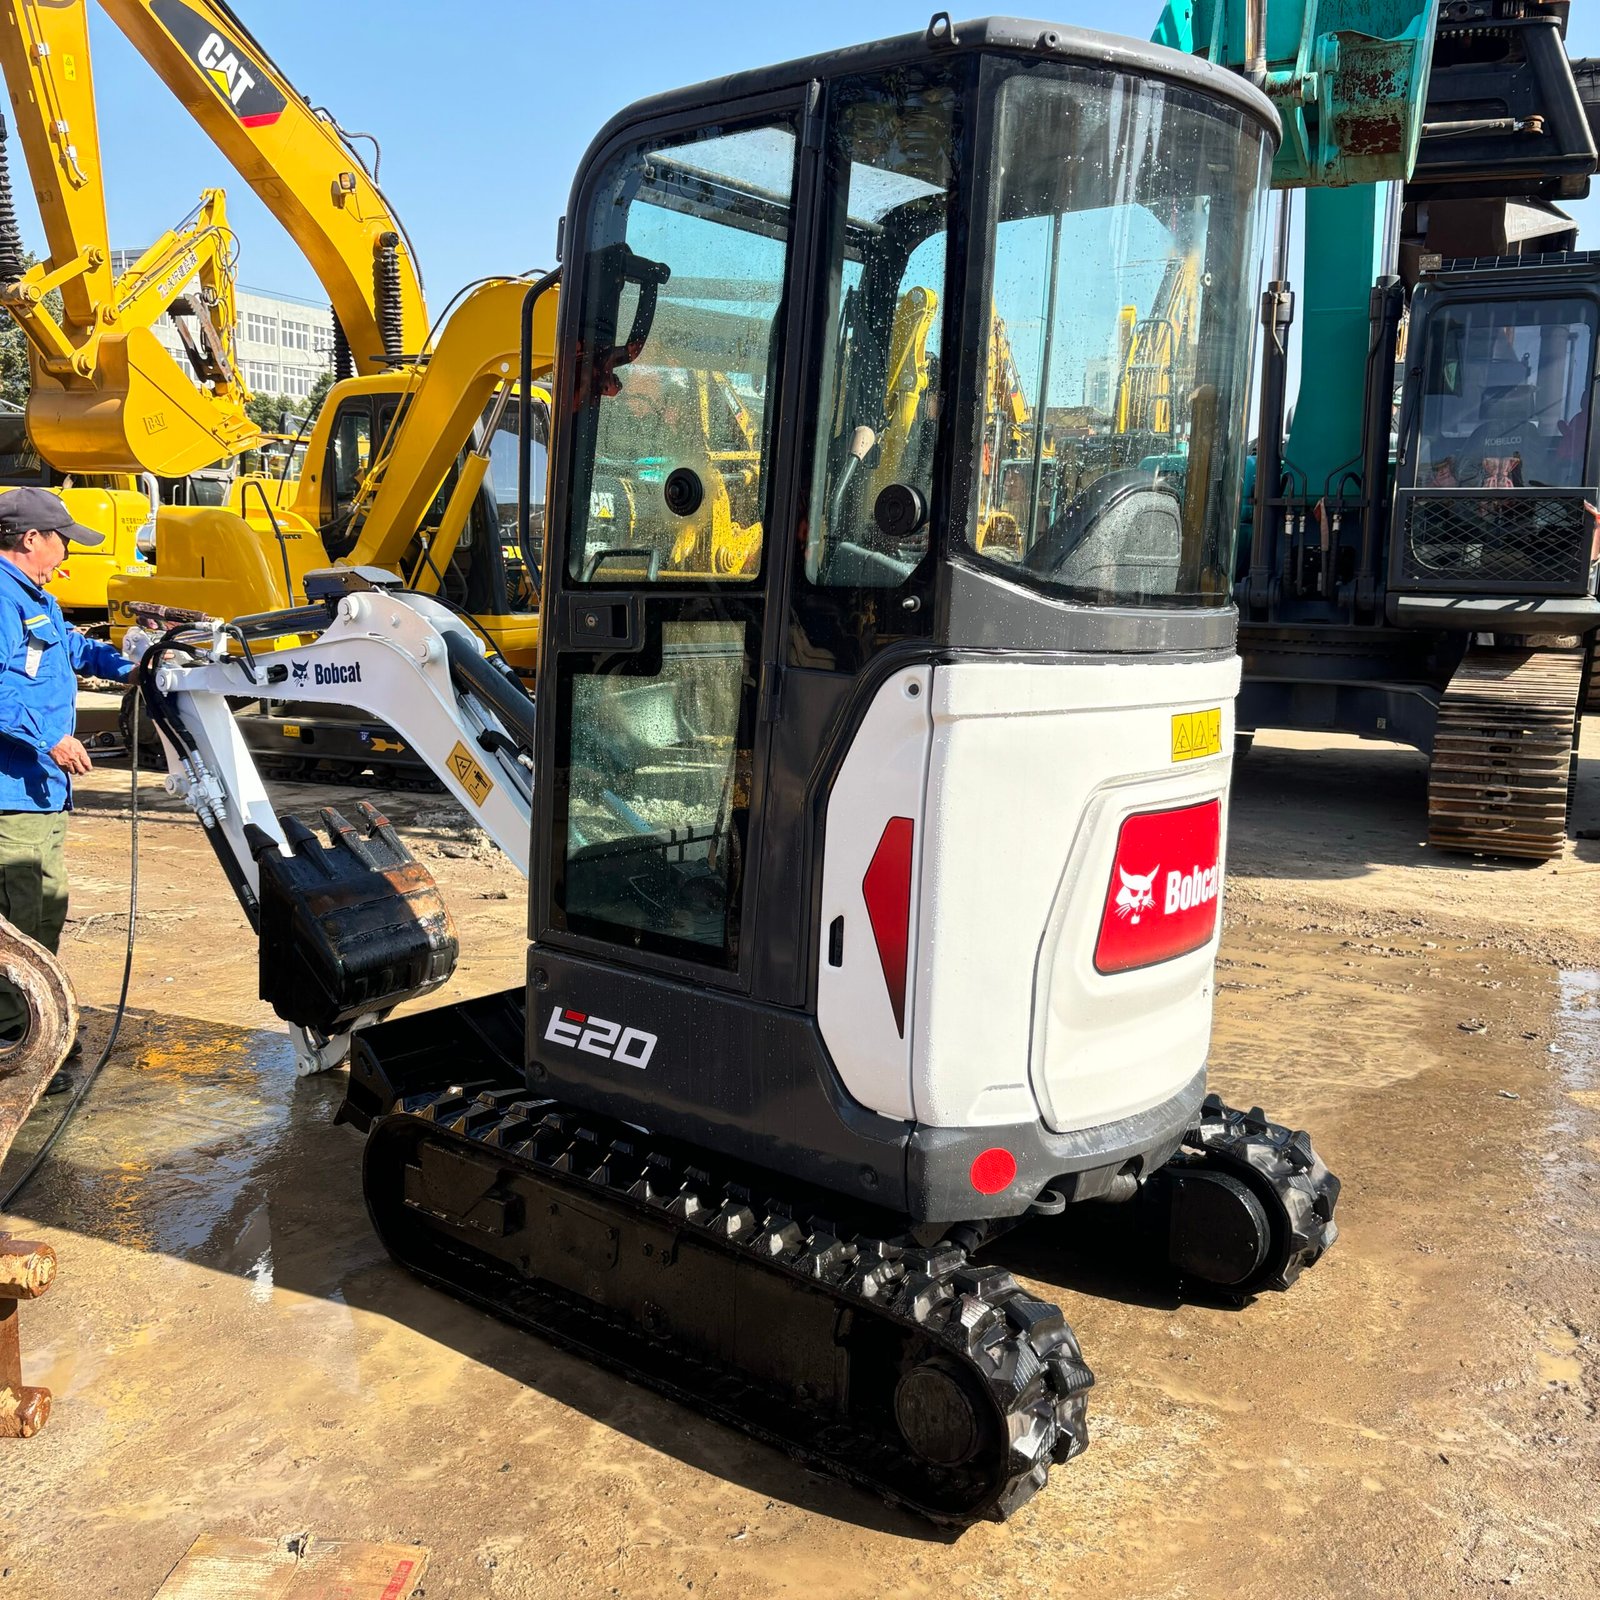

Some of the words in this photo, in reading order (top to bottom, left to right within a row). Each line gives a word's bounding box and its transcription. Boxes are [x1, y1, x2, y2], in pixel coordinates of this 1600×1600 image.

[198, 32, 256, 106] CAT
[145, 412, 167, 432] CAT
[1485, 436, 1522, 446] KOBELCO
[589, 491, 615, 519] CAT
[314, 660, 362, 685] Bobcat
[544, 1006, 658, 1070] E20
